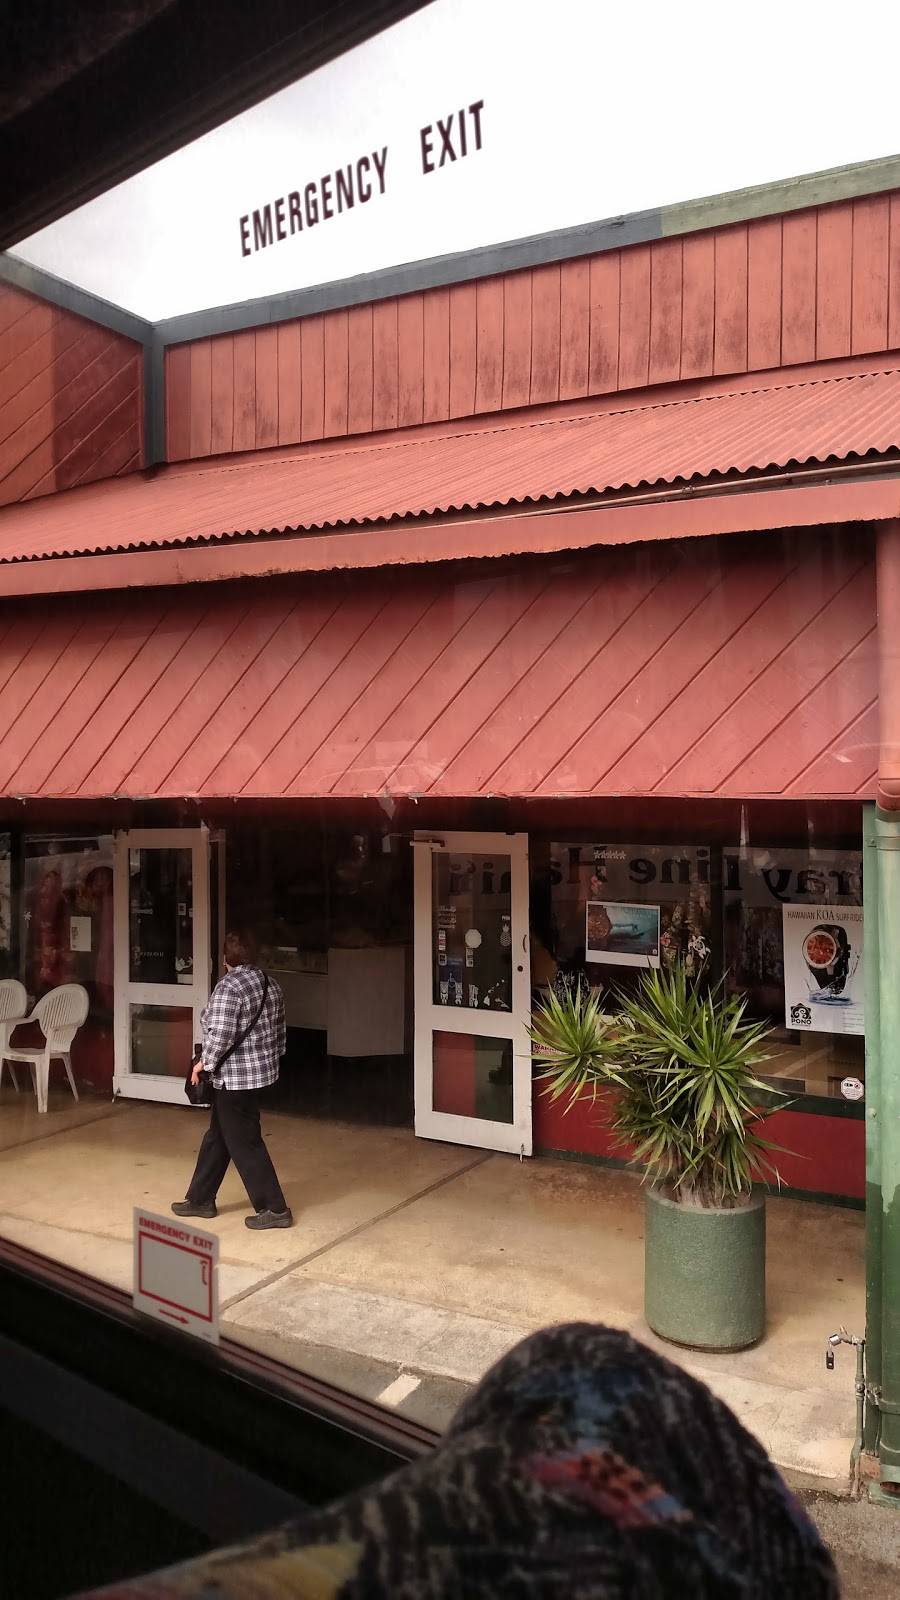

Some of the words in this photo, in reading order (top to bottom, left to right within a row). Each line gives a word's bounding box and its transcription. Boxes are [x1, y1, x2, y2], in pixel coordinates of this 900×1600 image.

[240, 147, 387, 257] EMERGENCY
[421, 101, 483, 174] EXIT
[788, 912, 815, 920] HAWAIIAN
[816, 909, 835, 921] KOA
[836, 913, 864, 922] SURFRIDE
[139, 1217, 190, 1242] EMERGENCY
[193, 1235, 213, 1250] EXIT
